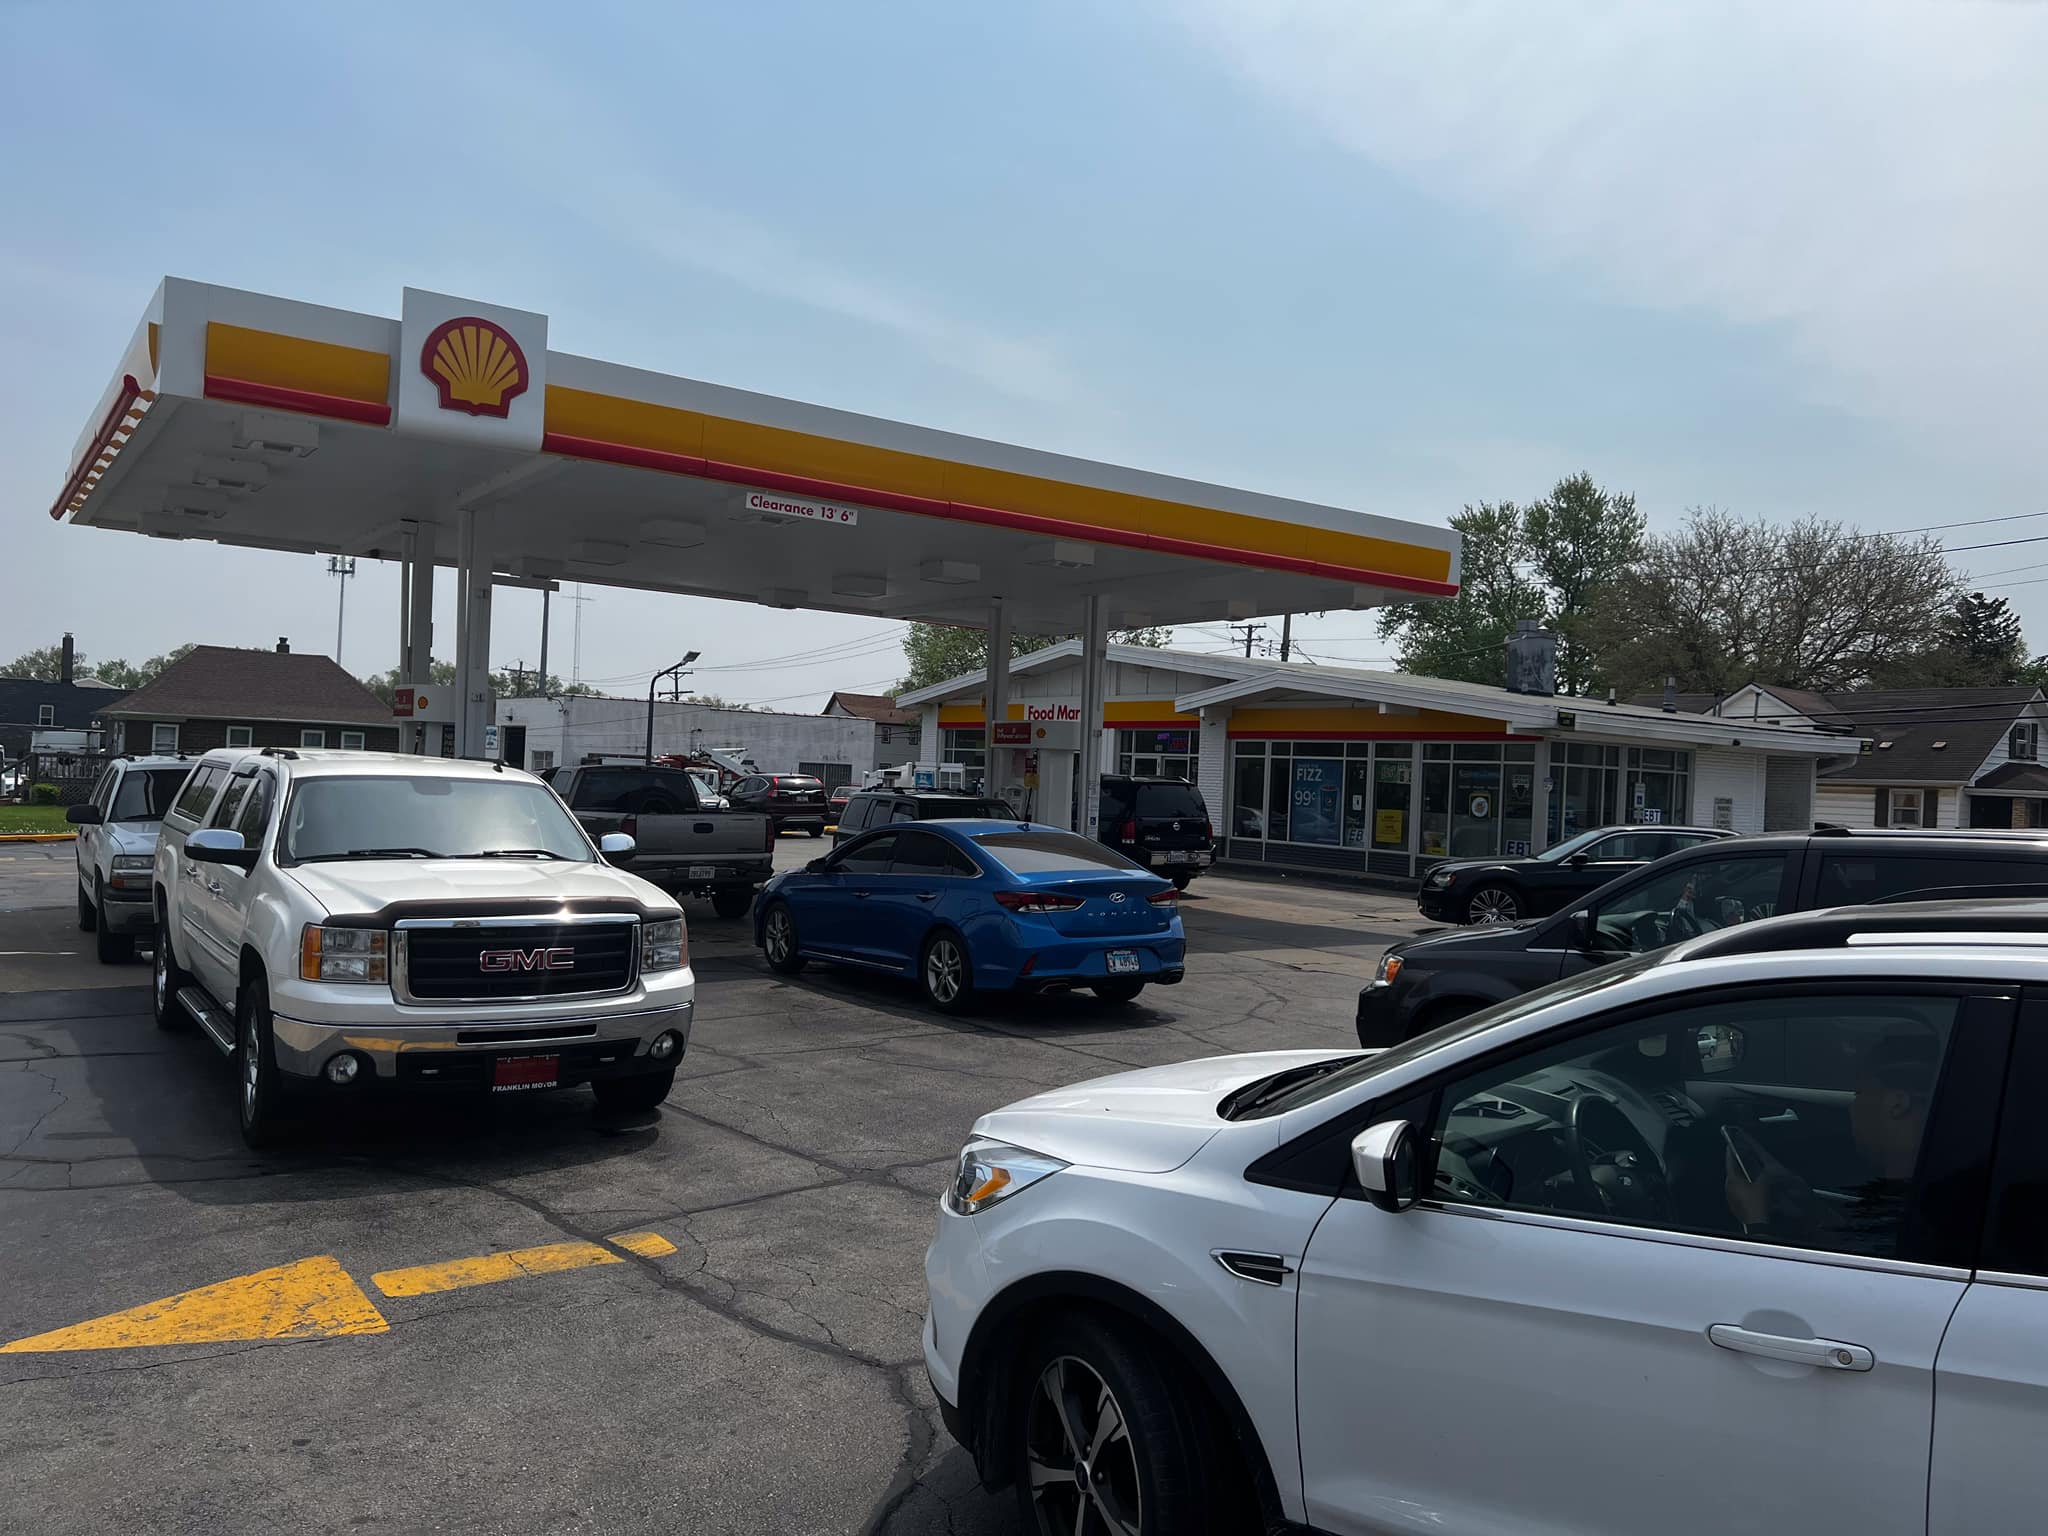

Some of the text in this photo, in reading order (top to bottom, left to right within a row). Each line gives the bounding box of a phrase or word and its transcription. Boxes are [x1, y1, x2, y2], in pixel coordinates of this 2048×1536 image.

[750, 495, 854, 522] Clearance 13' 6"
[1028, 703, 1080, 720] Food Mar
[1296, 768, 1323, 782] FIZZ
[1643, 809, 1661, 823] EBT
[1348, 829, 1364, 841] EB
[1507, 841, 1532, 855] EBT
[480, 947, 574, 972] GMC
[492, 1080, 557, 1092] FRANKLIN MOTOR
